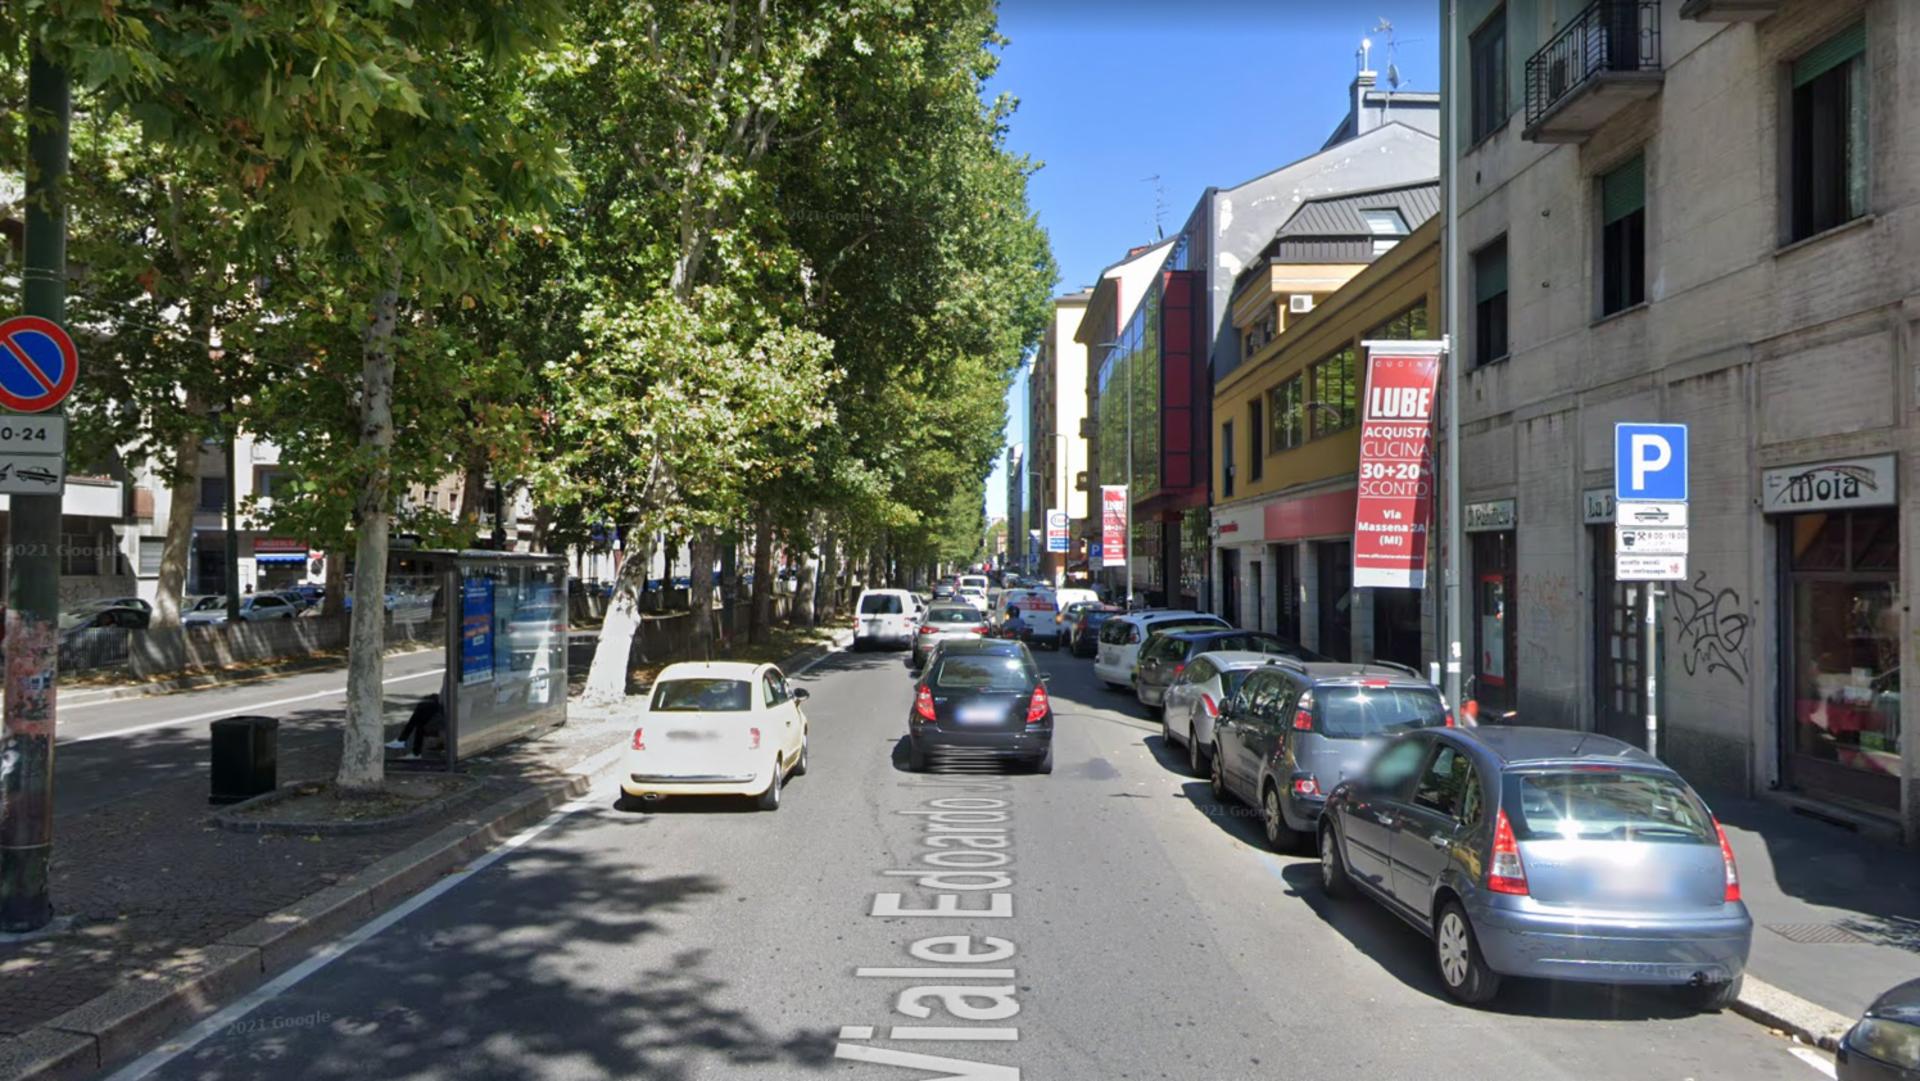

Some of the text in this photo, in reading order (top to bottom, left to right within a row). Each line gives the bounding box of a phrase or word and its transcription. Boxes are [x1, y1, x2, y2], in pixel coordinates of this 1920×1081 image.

[1371, 387, 1431, 418] LUBE
[1, 426, 46, 441] 0-24
[1364, 426, 1431, 440] ACQUISTA
[1363, 441, 1430, 457] CUCINA
[1632, 434, 1671, 491] P
[1360, 480, 1429, 497] SCONTO
[1358, 522, 1408, 532] Massena
[1379, 535, 1403, 547] (MI)
